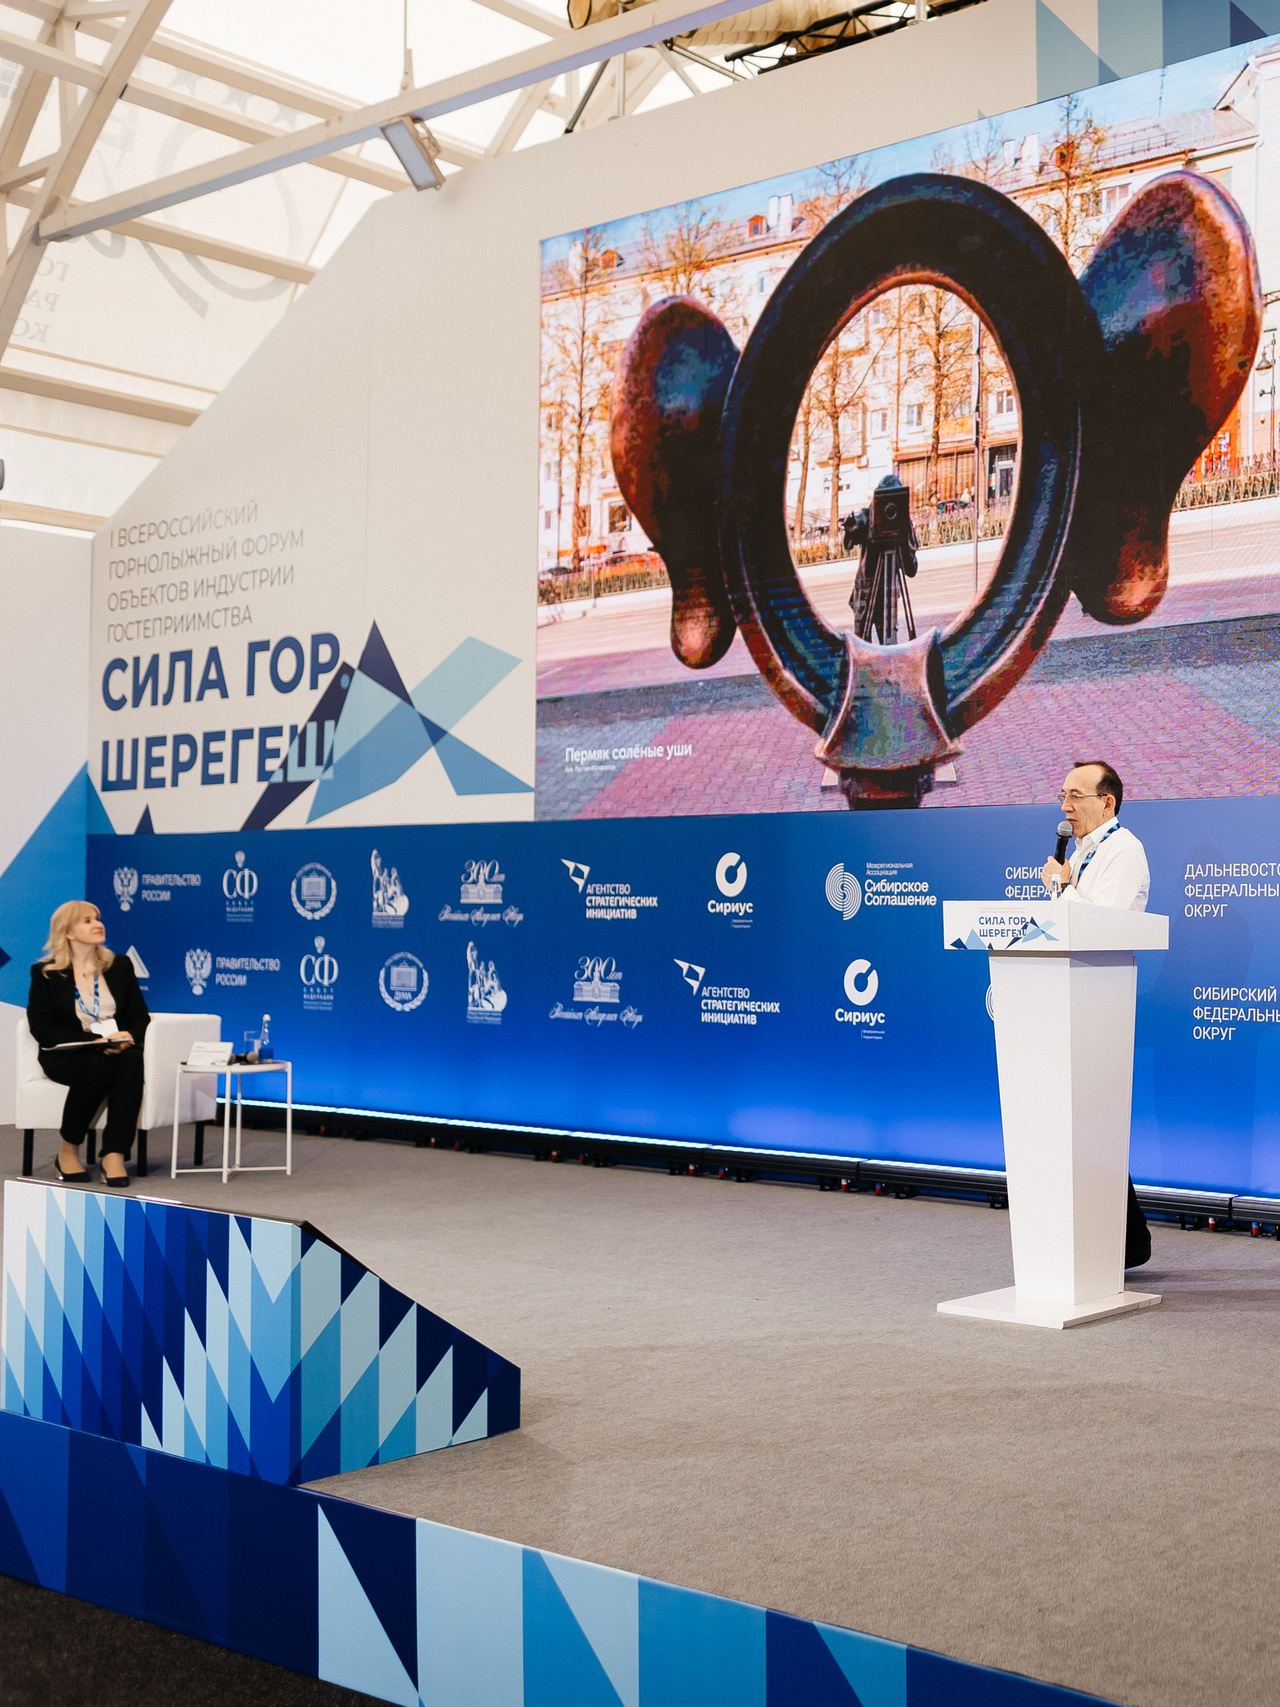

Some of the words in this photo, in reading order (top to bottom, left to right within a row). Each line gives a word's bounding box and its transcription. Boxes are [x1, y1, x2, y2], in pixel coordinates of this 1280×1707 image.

[118, 500, 258, 548] ВСЕРОССИЙСКИЙ
[109, 536, 237, 580] ГОРНОЛЫЖНЫЙ
[242, 529, 304, 558] ФОРУМ
[107, 577, 189, 612] ОБЪЕКТОВ
[193, 564, 294, 600] ИНДУСТРИИ
[107, 604, 252, 643] ГОСТЕПРИИМСТВА
[102, 646, 229, 711] СИЛА
[246, 632, 340, 696] ГОР
[101, 719, 335, 792] ШЕРЕГЕШ
[565, 747, 609, 765] Пермяк
[612, 743, 664, 760] солёные
[666, 743, 692, 761] уши
[141, 873, 202, 888] ПРАВИТЕЛЬСТВО
[1005, 866, 1043, 880] СИБИР
[222, 867, 258, 901] СФ
[585, 883, 631, 896] АГЕНТСТВО
[864, 879, 929, 894] Сибирское
[141, 889, 171, 902] РОССИИ
[864, 893, 937, 906] Соглашение
[1005, 885, 1052, 900] ФЕДЕРА
[585, 895, 659, 908] СТРАТЕГИЧЕСКИХ
[707, 900, 754, 916] Сириус
[585, 908, 638, 921] ИНИЦИАТИВ
[1184, 903, 1228, 918] ОКРУГ
[979, 916, 1006, 925] СИЛА
[1009, 916, 1027, 926] ГОР
[215, 956, 281, 972] ПРАВИТЕЛЬСТВО
[299, 951, 339, 988] СФ
[215, 972, 248, 987] РОССИИ
[701, 986, 750, 999] АГЕНТСТВО
[1193, 985, 1277, 1002] СИБИРСКИЙ
[701, 999, 781, 1013] СТРАТЕГИЧЕСКИХ
[701, 1012, 757, 1026] ИНИЦИАТИВ
[835, 1008, 886, 1026] Сириус
[1193, 1026, 1236, 1041] ОКРУГ
